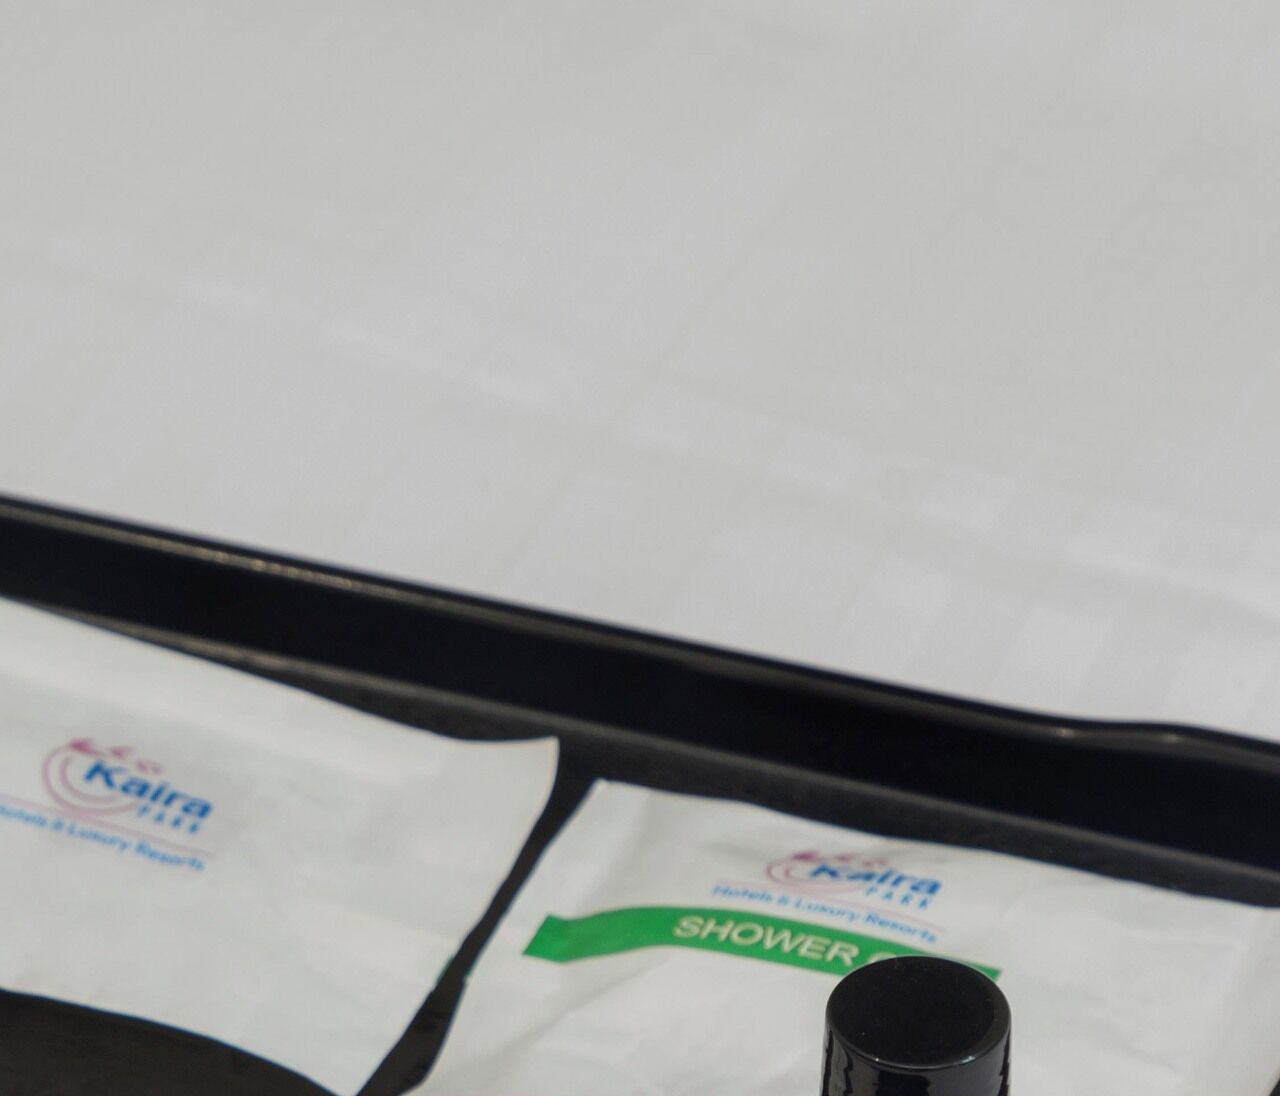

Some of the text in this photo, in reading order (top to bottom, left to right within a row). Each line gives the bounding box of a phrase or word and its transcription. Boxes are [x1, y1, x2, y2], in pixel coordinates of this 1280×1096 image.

[84, 760, 213, 818] Kaira
[810, 863, 942, 896] Kaira
[673, 915, 860, 966] SHOWER
[712, 884, 772, 904] Hotels
[795, 898, 860, 923] Luxury
[864, 911, 937, 944] Resorts
